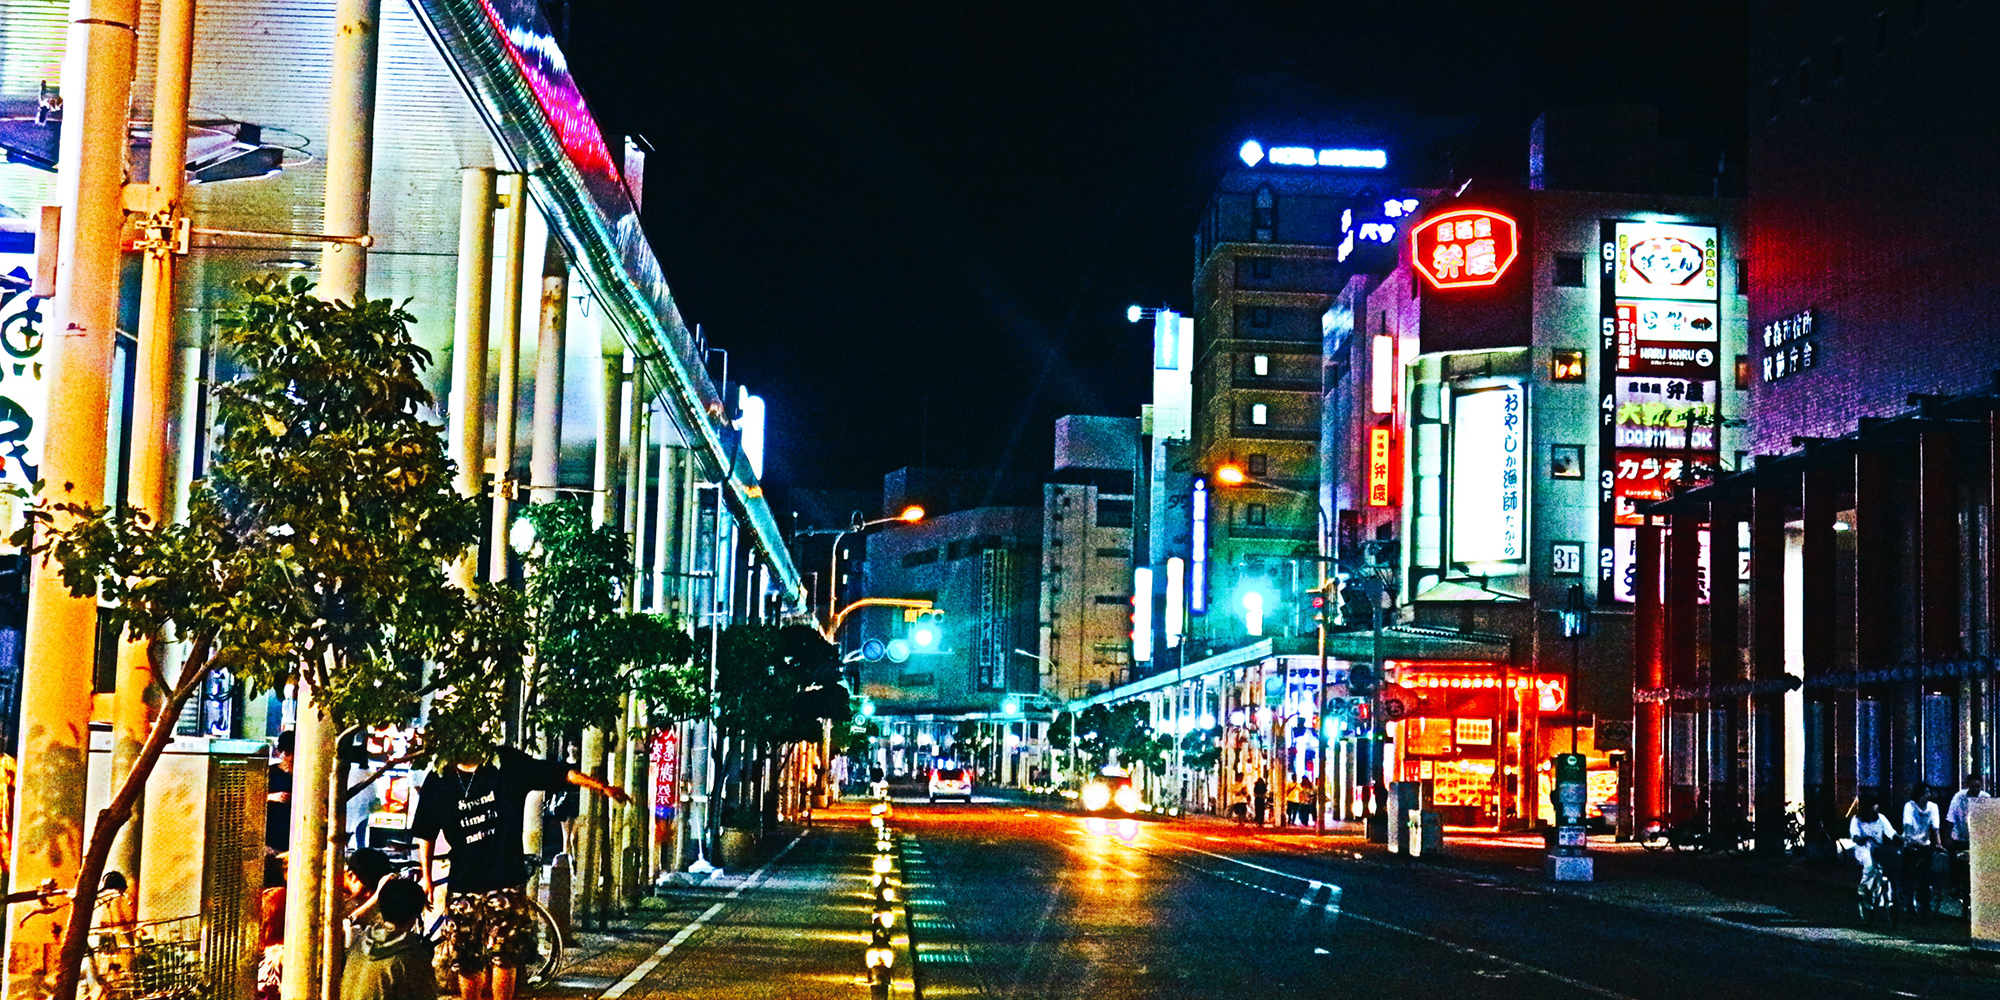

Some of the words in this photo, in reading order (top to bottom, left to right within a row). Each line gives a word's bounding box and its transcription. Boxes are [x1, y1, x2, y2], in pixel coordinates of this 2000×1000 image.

[1437, 217, 1492, 242] 居酒屋
[1433, 239, 1497, 279] 弁慶
[1763, 310, 1812, 347] 青森市役所
[1668, 348, 1695, 361] HARU
[1667, 380, 1703, 402] 弁慶
[1691, 433, 1713, 447] OK
[1373, 462, 1387, 502] 弁慶
[1553, 550, 1578, 570] 3F
[458, 790, 495, 811] Spend
[460, 814, 486, 827] time
